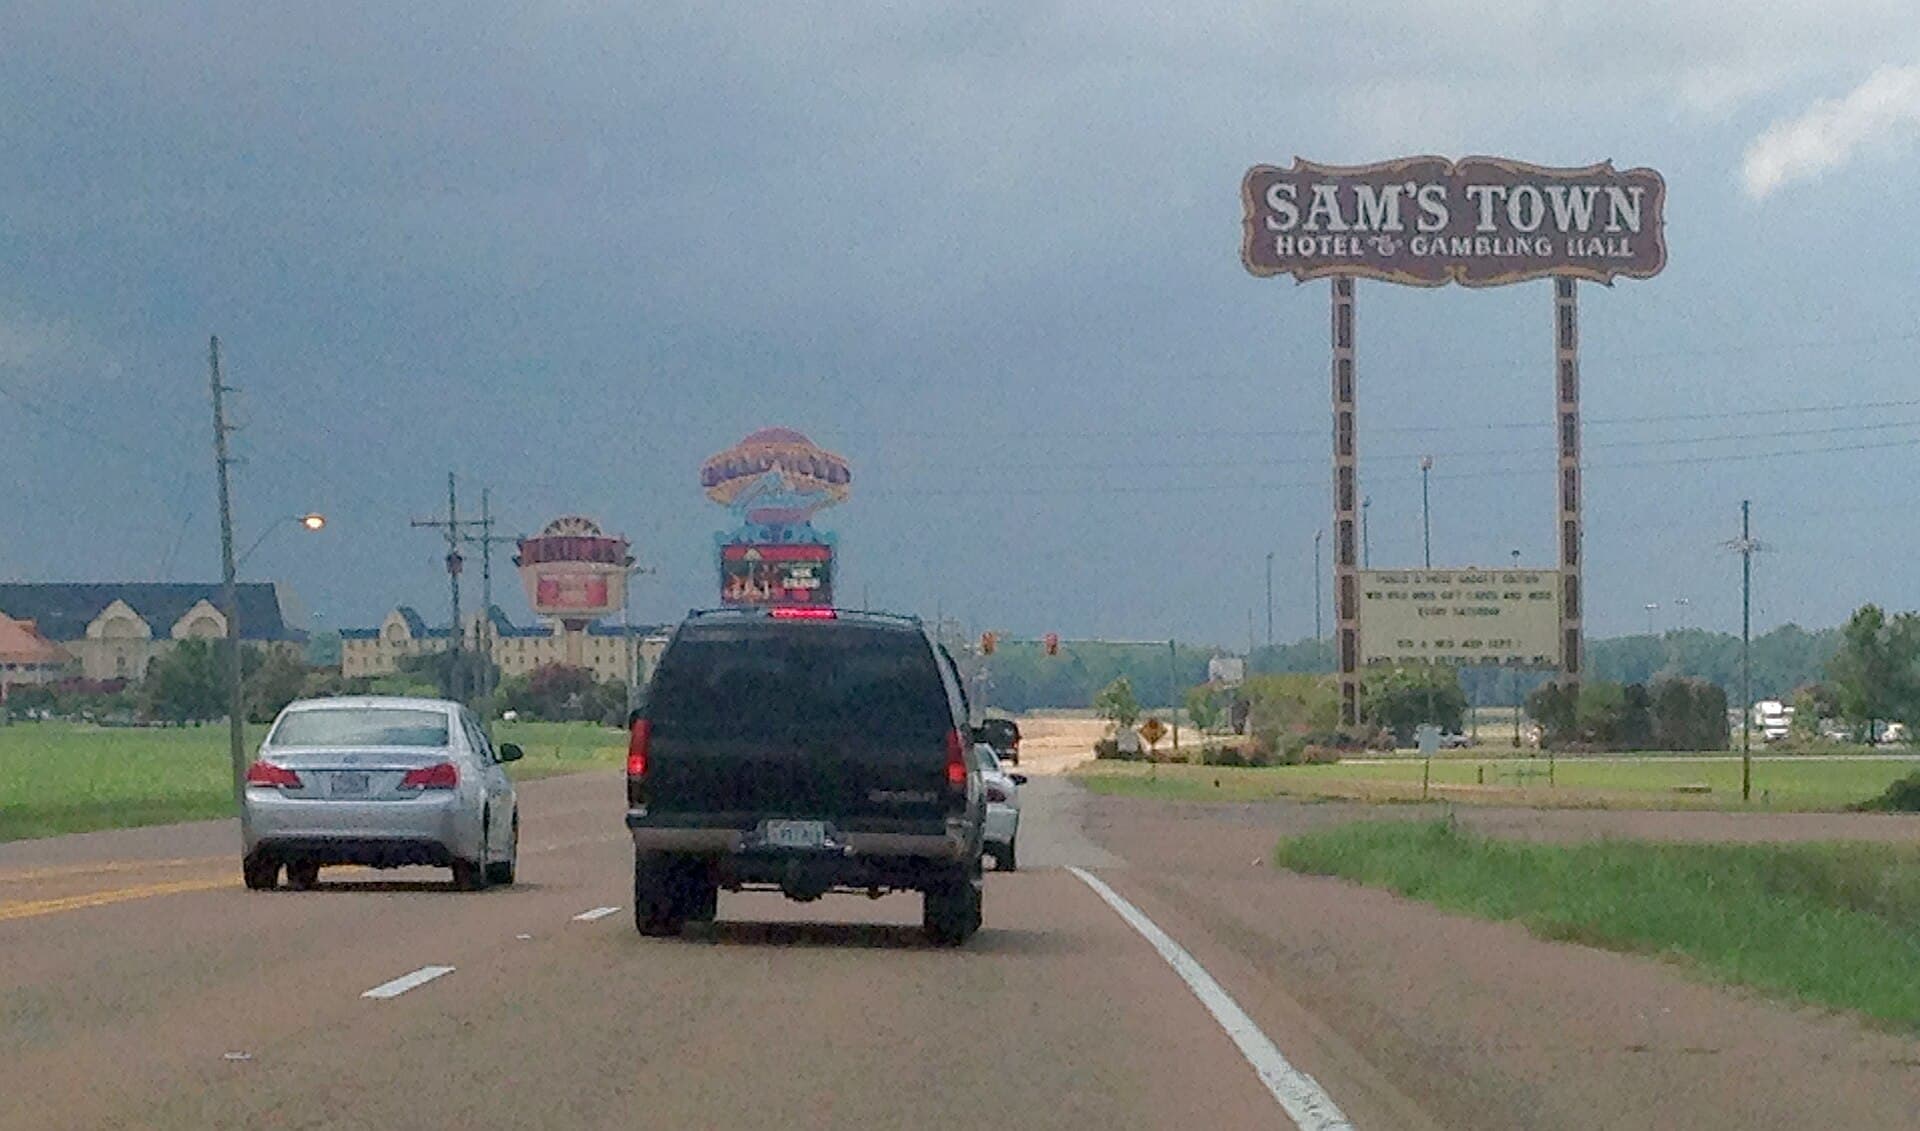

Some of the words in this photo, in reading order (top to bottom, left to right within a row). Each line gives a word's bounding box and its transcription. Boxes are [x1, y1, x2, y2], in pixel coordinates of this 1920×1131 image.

[1266, 182, 1449, 233] SAM'S
[1466, 184, 1645, 234] TOWN
[1275, 235, 1364, 257] HOTEL
[1410, 236, 1552, 257] GAMBLING
[1567, 237, 1635, 257] HALL
